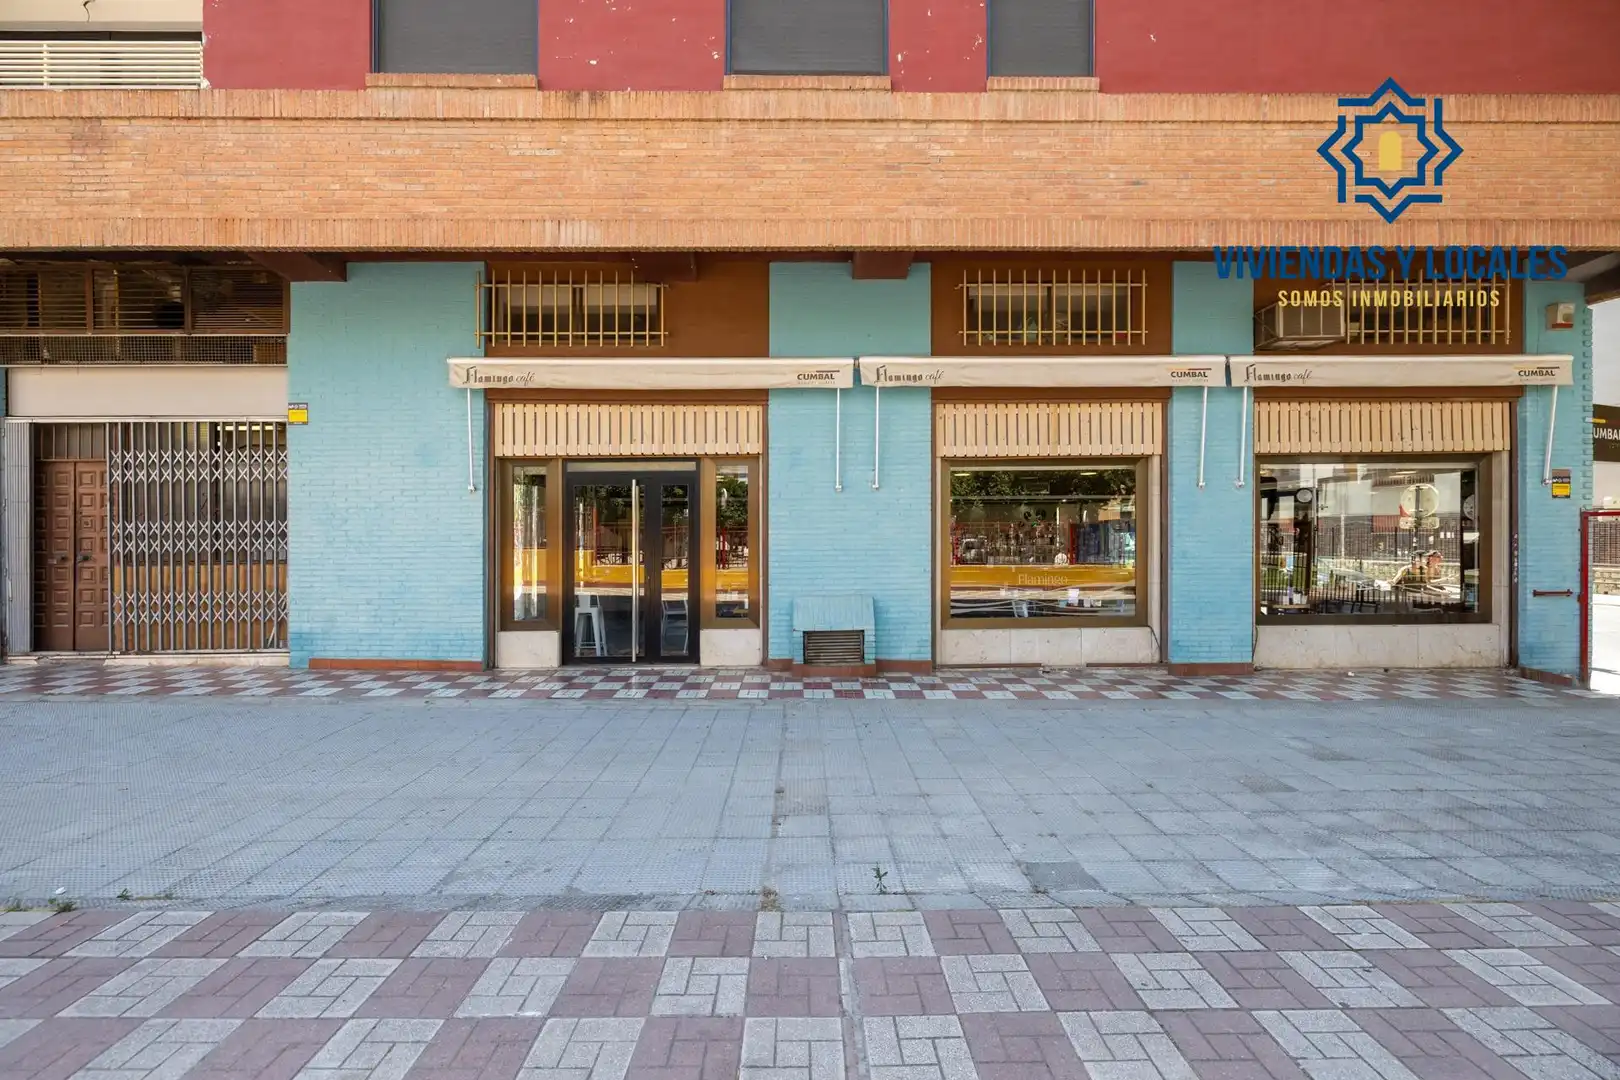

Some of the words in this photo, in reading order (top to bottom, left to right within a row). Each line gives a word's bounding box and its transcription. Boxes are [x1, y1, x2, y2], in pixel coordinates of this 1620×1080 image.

[462, 365, 514, 384] Flamingo
[797, 373, 836, 381] CUMBAL
[874, 364, 923, 384] Flamingo
[1244, 363, 1292, 382] Flamingo
[1518, 369, 1556, 377] CUMBAL
[1593, 427, 1620, 440] UMBA
